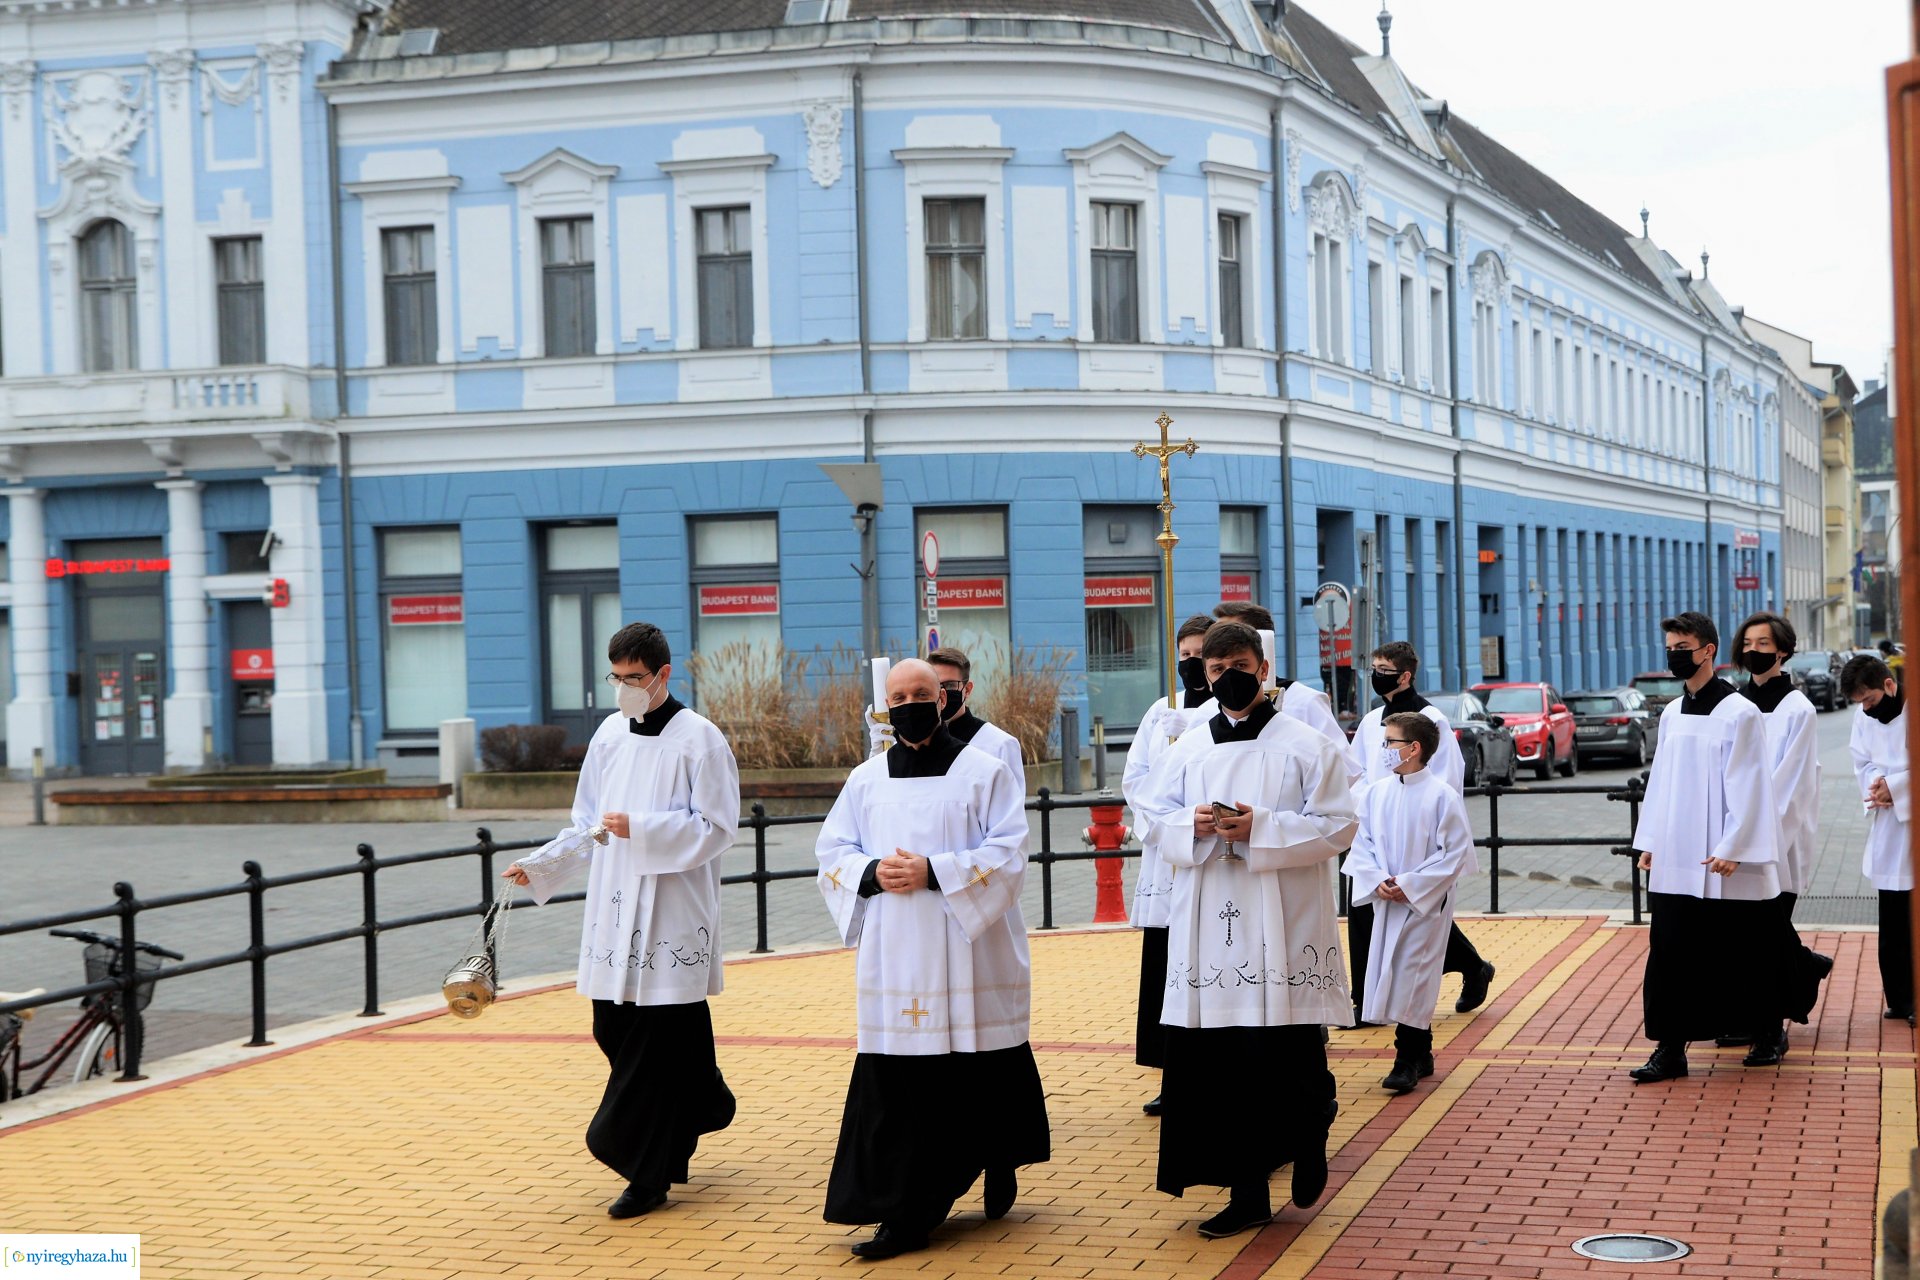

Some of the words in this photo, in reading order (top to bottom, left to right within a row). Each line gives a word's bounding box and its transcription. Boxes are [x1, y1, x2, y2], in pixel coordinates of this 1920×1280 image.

[924, 590, 974, 599] DAPEST
[975, 588, 1002, 598] BANK
[1083, 587, 1127, 598] BUDAPEST
[1128, 586, 1152, 597] BANK
[701, 595, 749, 606] BUDAPEST
[750, 595, 777, 604] BANK
[391, 605, 435, 616] BUDAPEST
[436, 605, 461, 614] BANK
